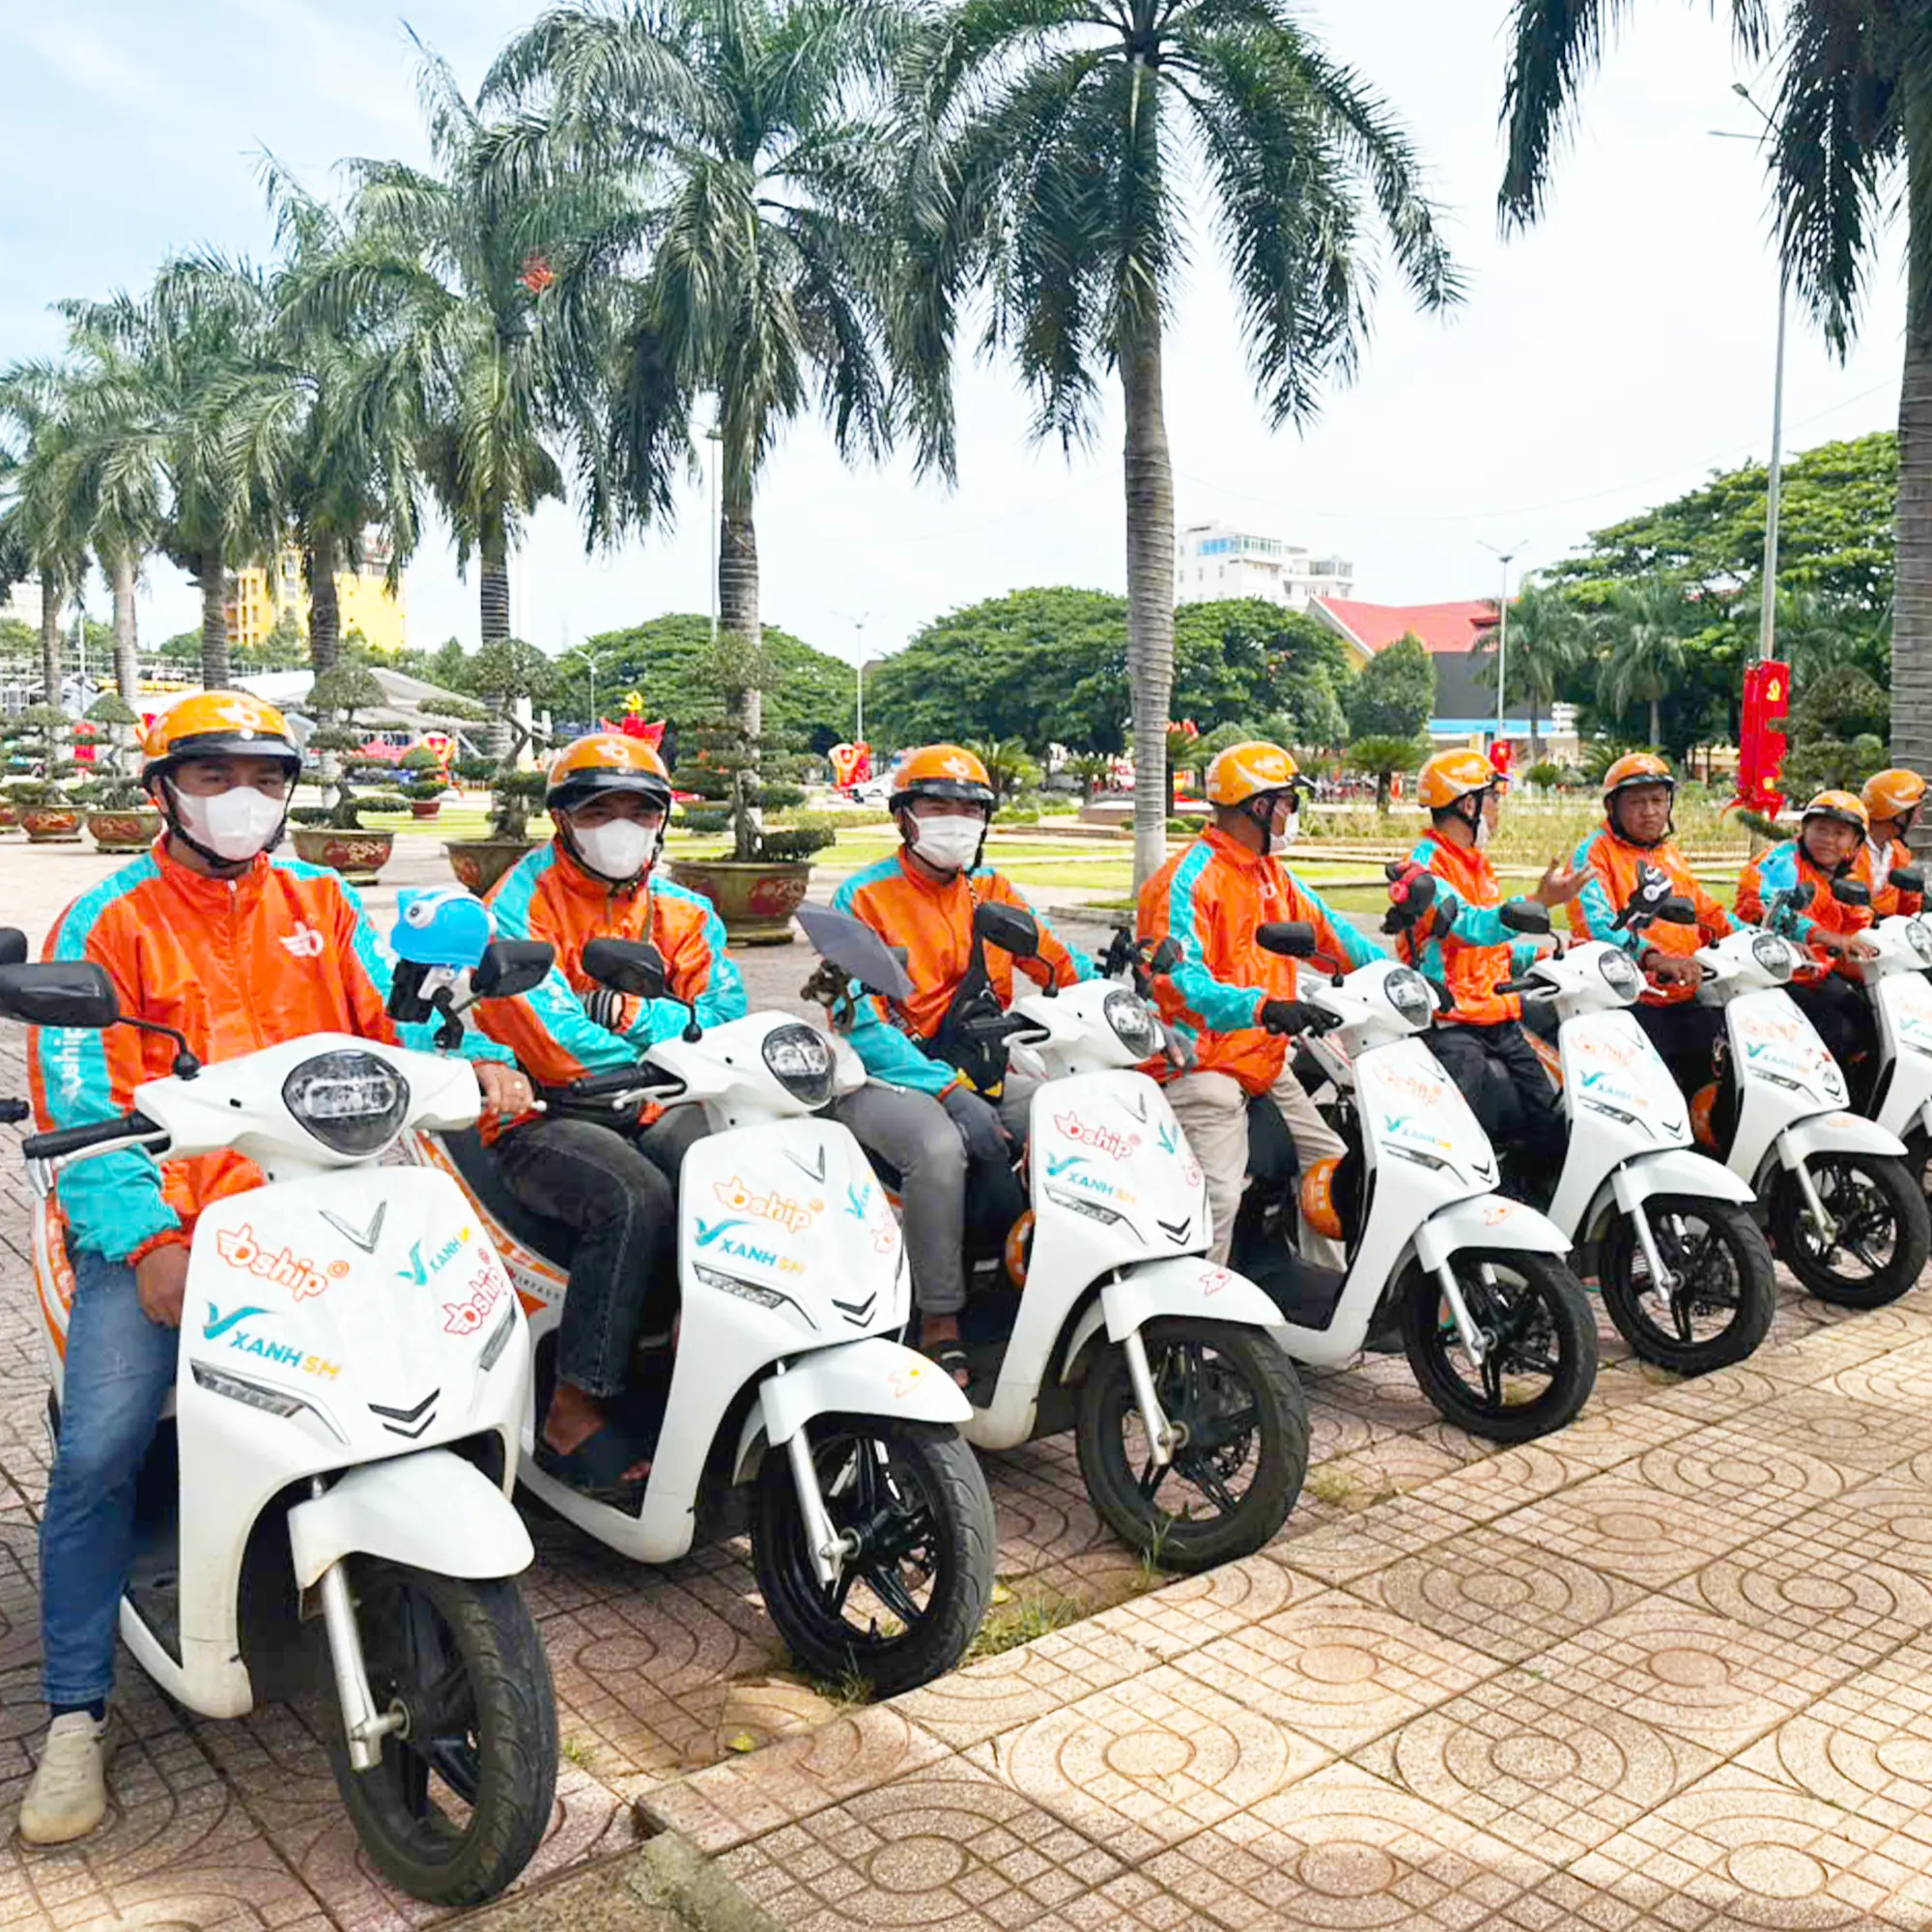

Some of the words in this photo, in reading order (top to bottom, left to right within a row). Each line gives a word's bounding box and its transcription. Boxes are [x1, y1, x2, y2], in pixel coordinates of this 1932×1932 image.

[1068, 1171, 1115, 1197] XANH
[430, 1237, 463, 1274] XANH
[718, 1237, 777, 1267] XANH
[229, 1330, 303, 1368] XANH
[301, 1354, 343, 1380] SM
